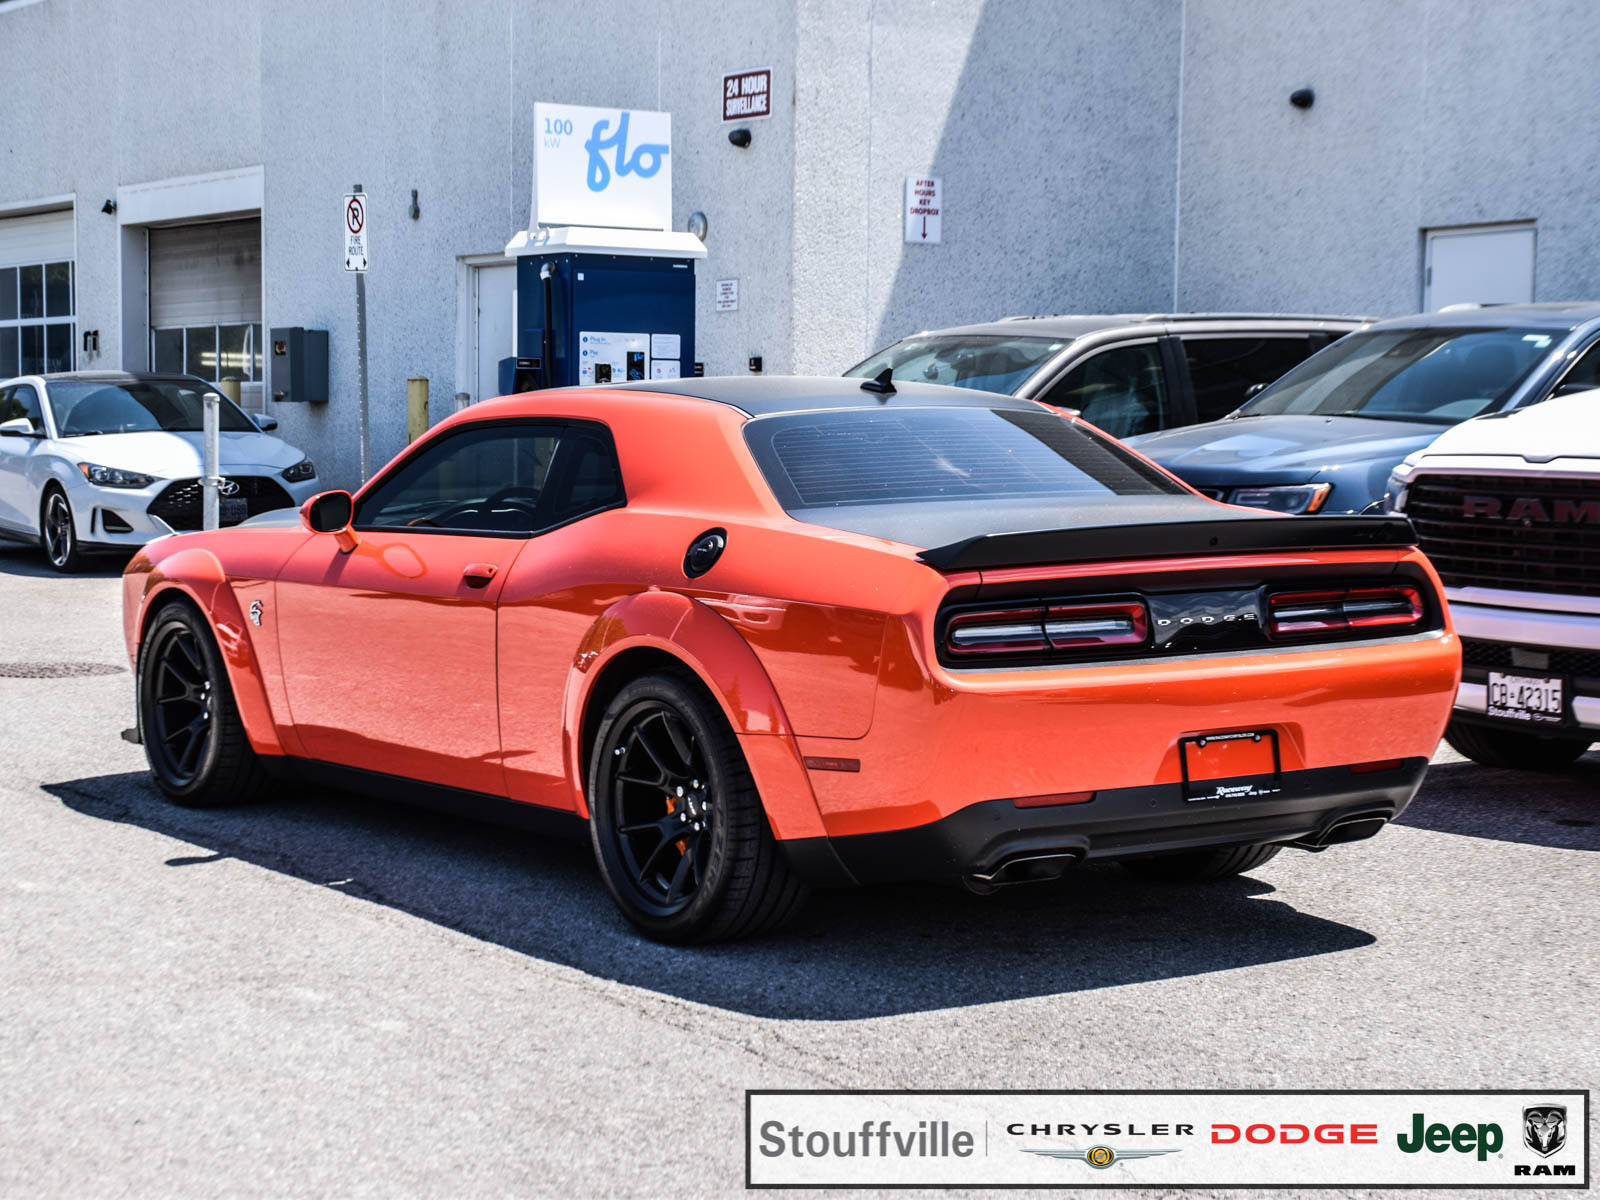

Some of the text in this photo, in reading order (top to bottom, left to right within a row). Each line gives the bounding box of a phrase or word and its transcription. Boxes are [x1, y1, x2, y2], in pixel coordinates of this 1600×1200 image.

[726, 74, 767, 97] 24 HOUR
[544, 117, 573, 136] 100
[584, 111, 670, 193] flo
[914, 189, 936, 197] HOURS
[909, 207, 939, 216] DROPBOX
[350, 236, 361, 245] FIRE
[348, 246, 364, 256] ROUTE
[1463, 495, 1600, 523] RAM
[1157, 613, 1256, 626] DODGE
